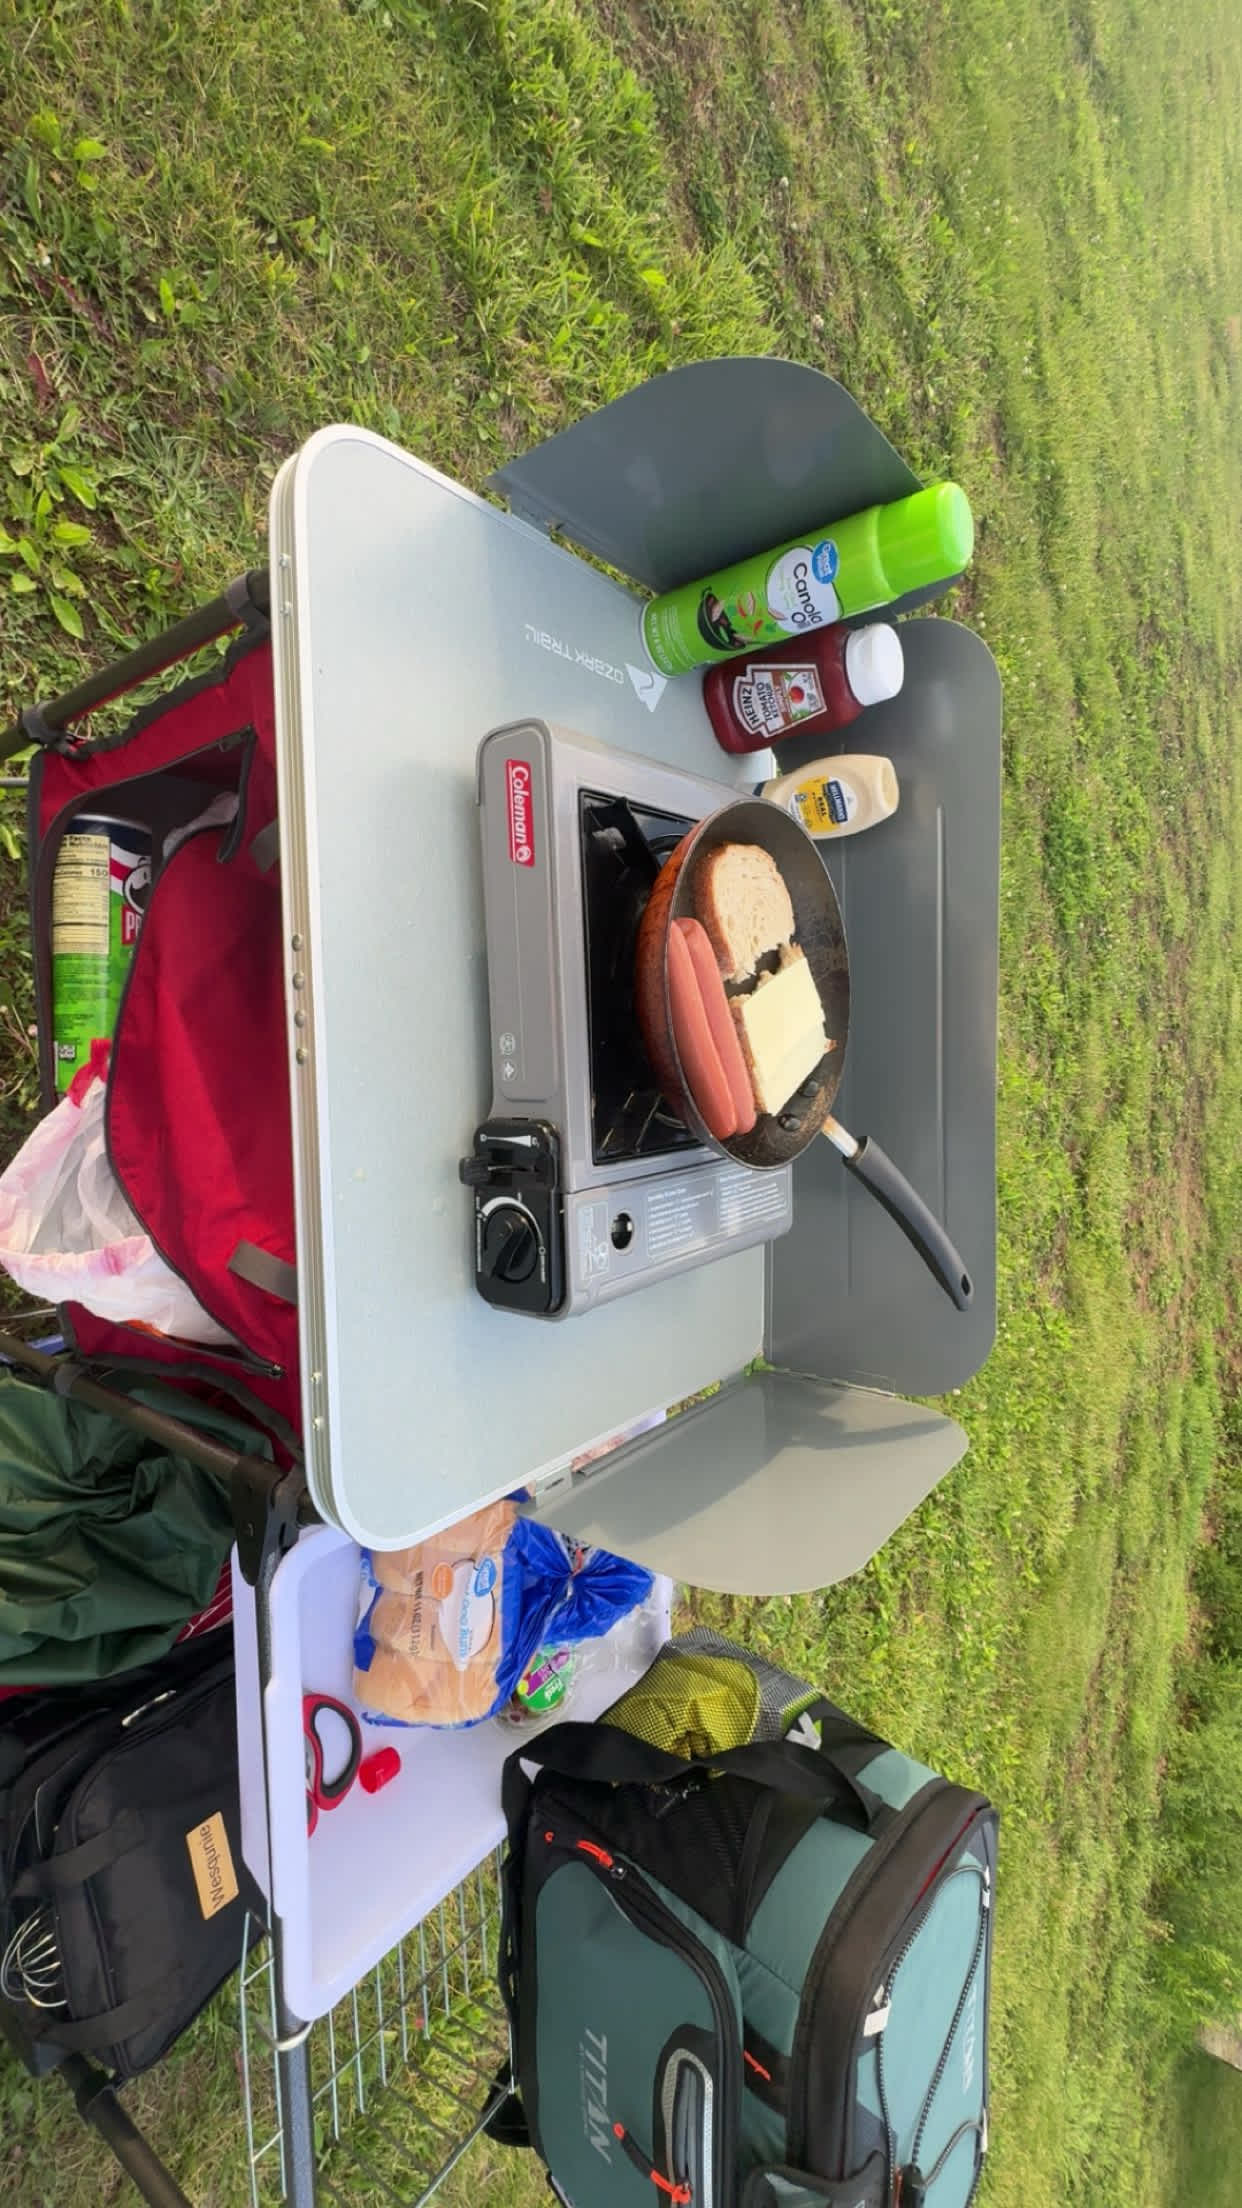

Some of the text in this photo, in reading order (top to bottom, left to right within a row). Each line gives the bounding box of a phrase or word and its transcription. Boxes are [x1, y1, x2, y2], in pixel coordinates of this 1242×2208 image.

[793, 562, 824, 625] Canola
[742, 686, 760, 724] HEINZ
[756, 682, 774, 721] TOMATO
[511, 766, 529, 843] Coleman
[585, 2028, 611, 2165] TITAN
